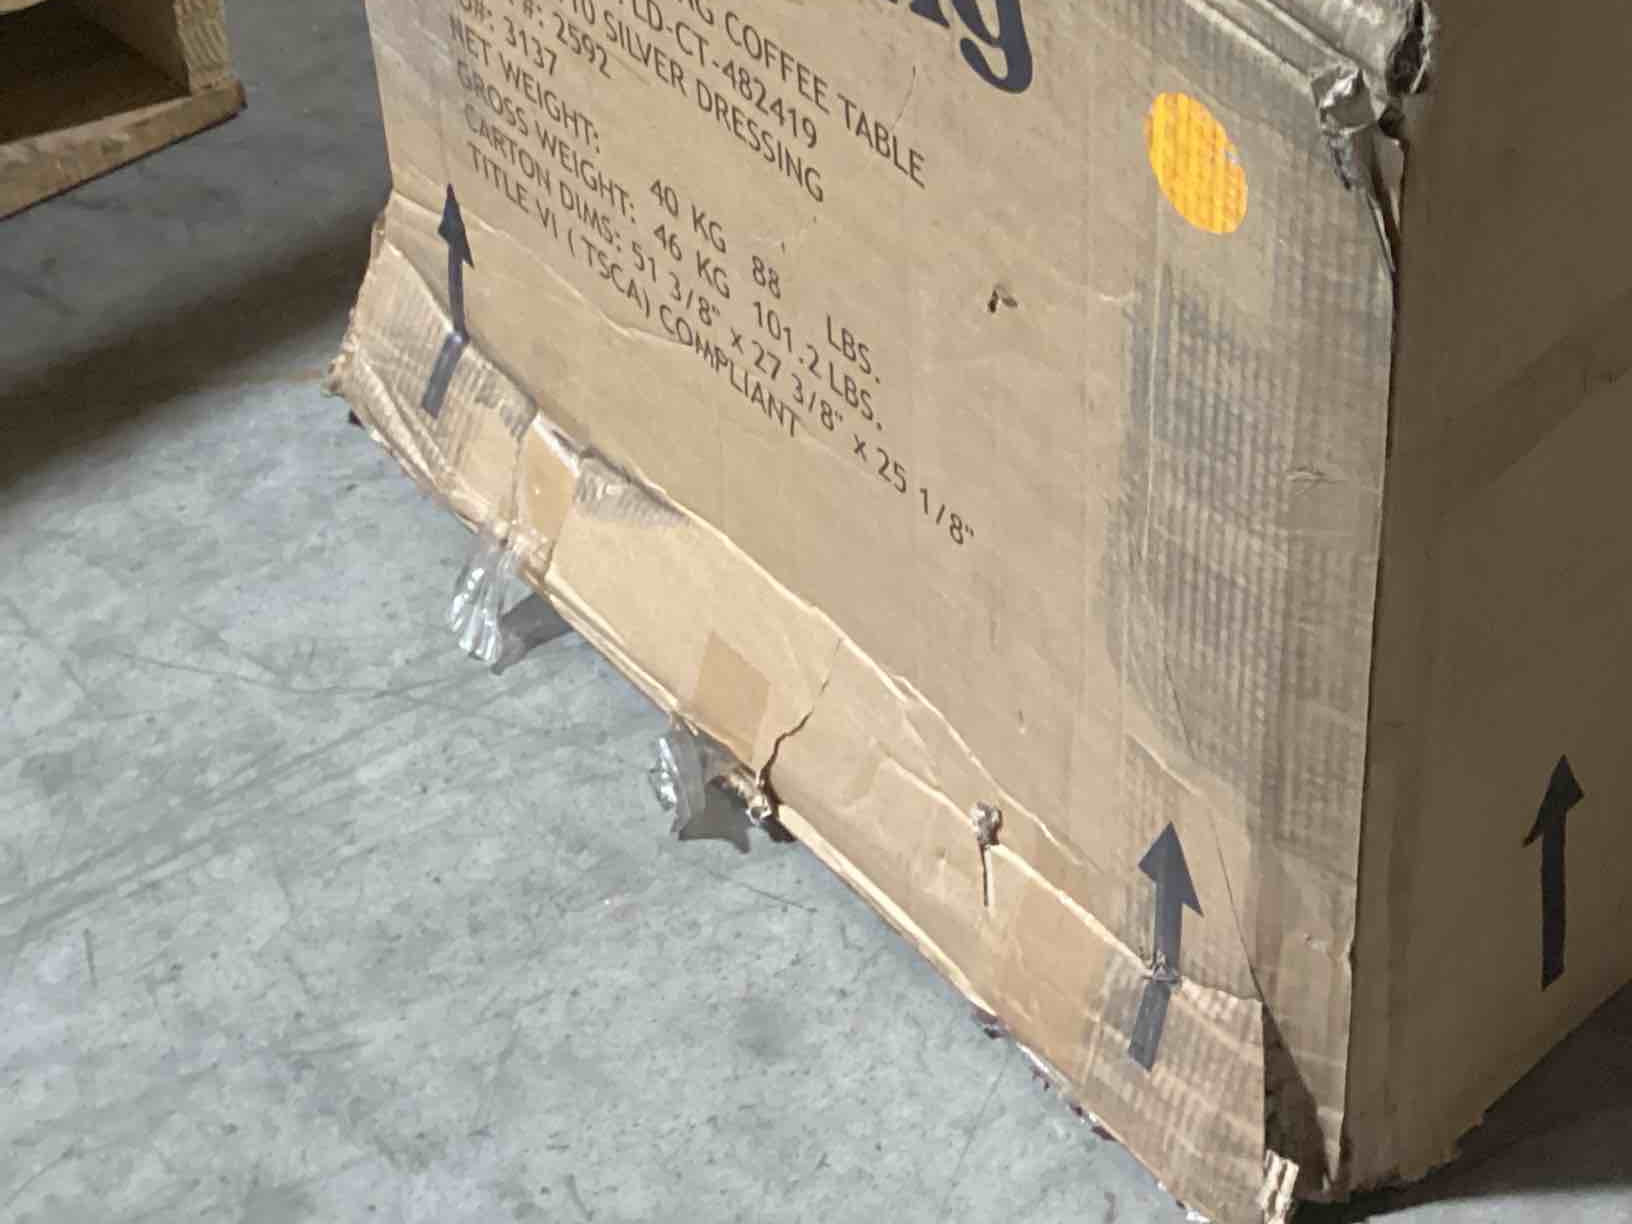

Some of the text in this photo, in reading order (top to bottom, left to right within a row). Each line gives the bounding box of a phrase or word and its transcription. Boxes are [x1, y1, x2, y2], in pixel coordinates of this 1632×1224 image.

[503, 15, 557, 77] 3137
[552, 11, 612, 79] 2592
[604, 10, 687, 97] SILVER
[696, 78, 824, 202] DRESSING
[725, 11, 830, 114] COFFEE
[837, 93, 926, 189] TABLE
[450, 14, 881, 384] NET WEIGHT: 40 KG 88 LBS.
[457, 58, 529, 137] GROSS
[534, 119, 636, 224] WEIGHT:
[653, 224, 683, 262] 46
[696, 250, 730, 299] KG
[828, 361, 882, 431] LBS.
[465, 104, 551, 196] CARTON
[559, 180, 622, 253] DIMS:
[631, 240, 657, 283] 51
[752, 341, 782, 380] 27
[876, 447, 907, 494] 25
[467, 141, 529, 213] TITLE
[536, 197, 558, 239] VI
[659, 304, 801, 437] COMPLIANT
